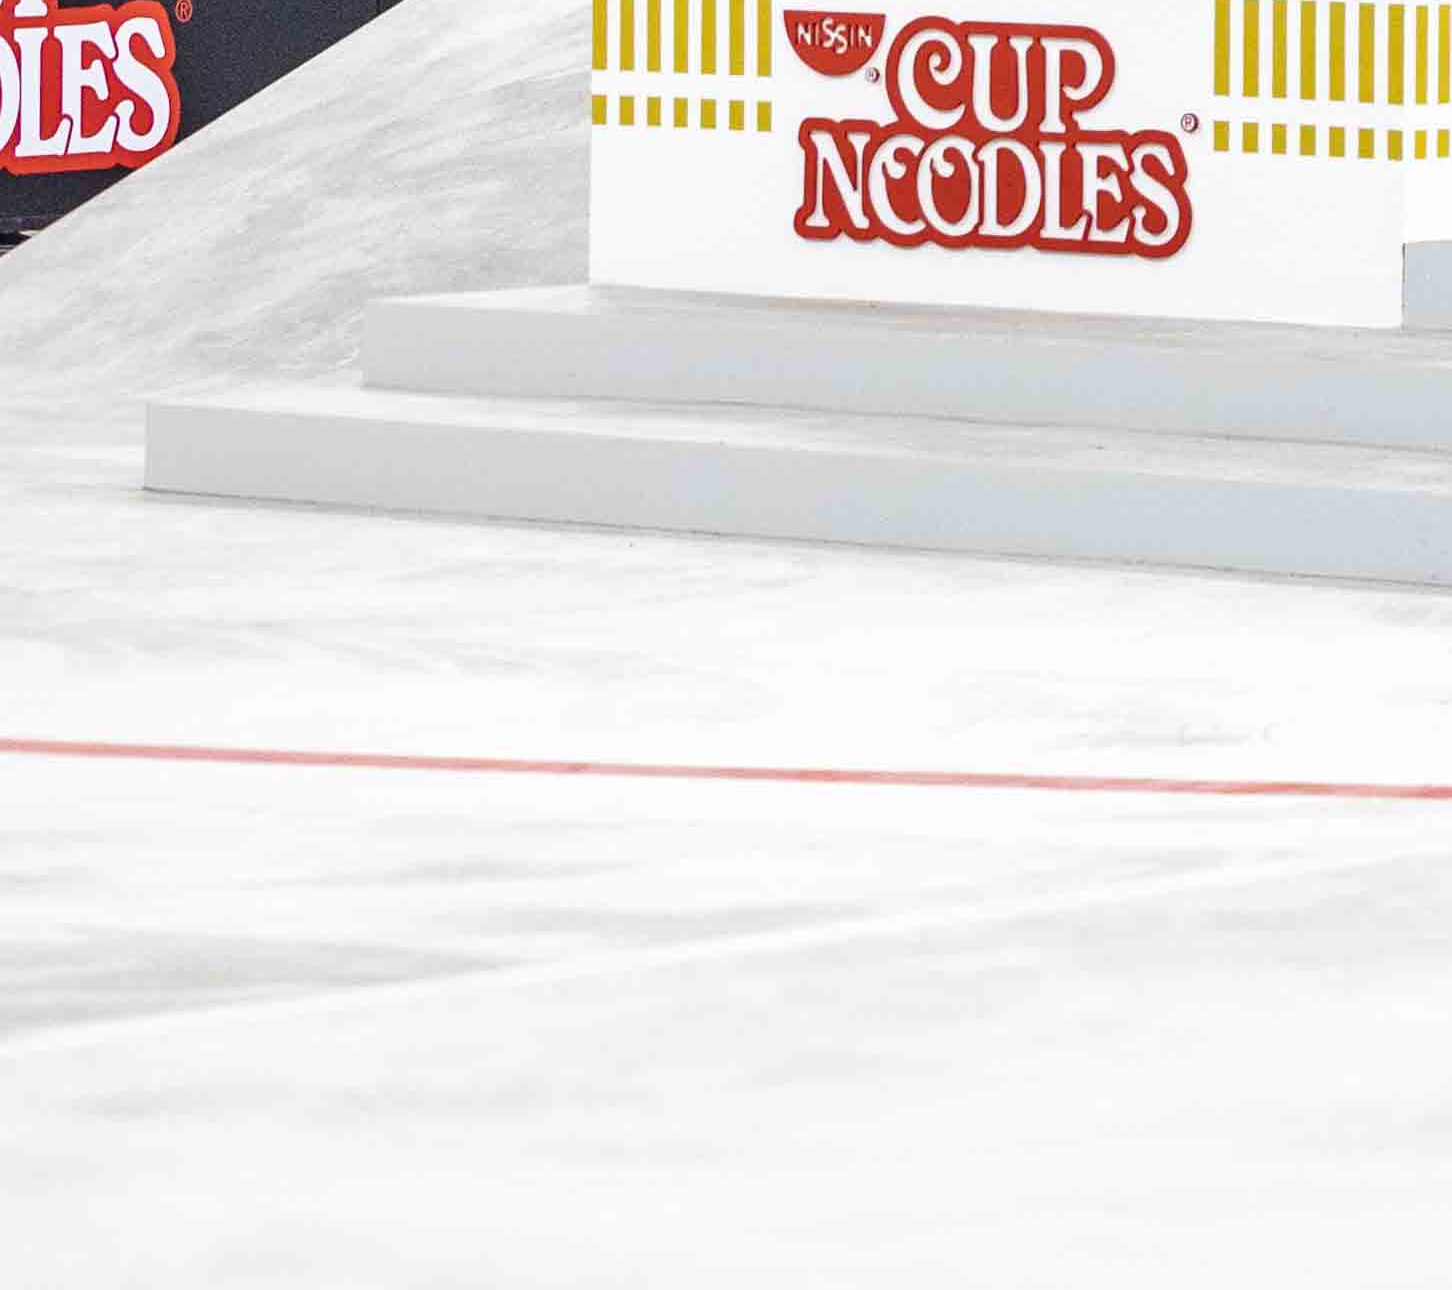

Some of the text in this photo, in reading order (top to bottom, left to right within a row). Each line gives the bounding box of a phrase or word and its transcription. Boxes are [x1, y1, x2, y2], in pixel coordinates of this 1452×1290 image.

[798, 17, 873, 55] NISSIN
[896, 26, 1105, 134] CUP
[805, 129, 1180, 247] NOODLES
